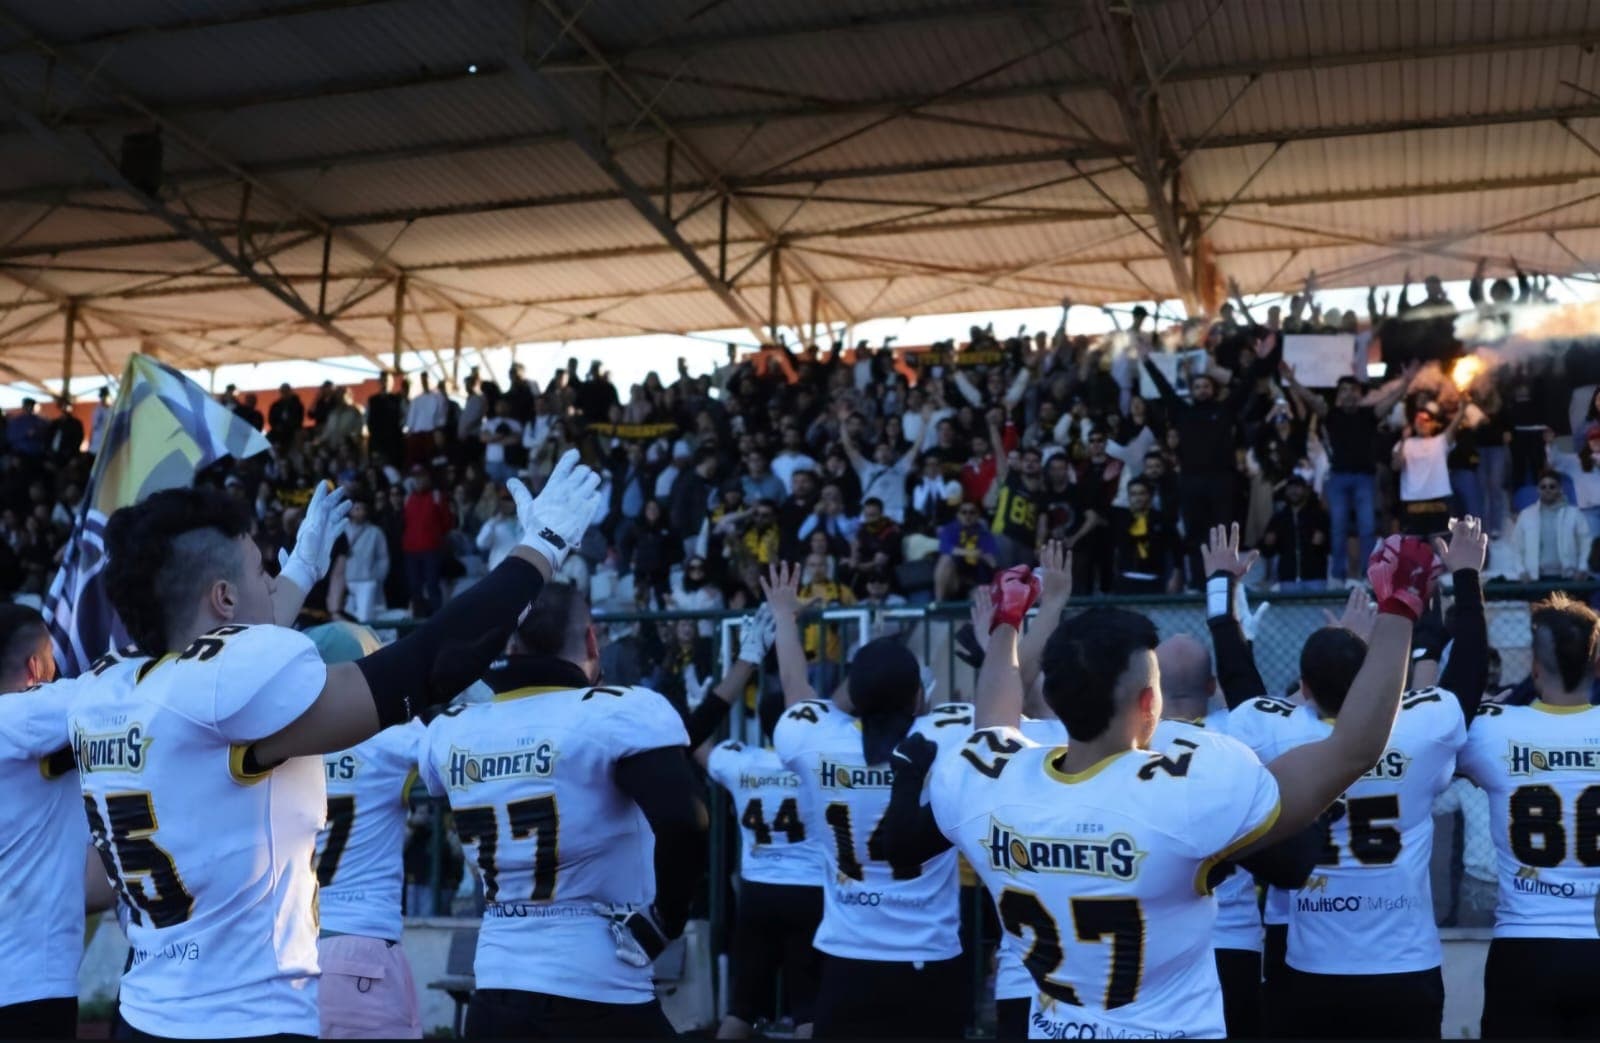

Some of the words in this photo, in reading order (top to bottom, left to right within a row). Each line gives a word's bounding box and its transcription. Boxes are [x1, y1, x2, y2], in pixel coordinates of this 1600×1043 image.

[449, 743, 552, 786] HORNETS
[820, 761, 895, 790] HORNE
[1511, 745, 1600, 774] HORNE
[741, 797, 806, 845] 44
[451, 794, 560, 902] 77
[989, 824, 1136, 878] HORNETS
[998, 887, 1148, 1010] 27
